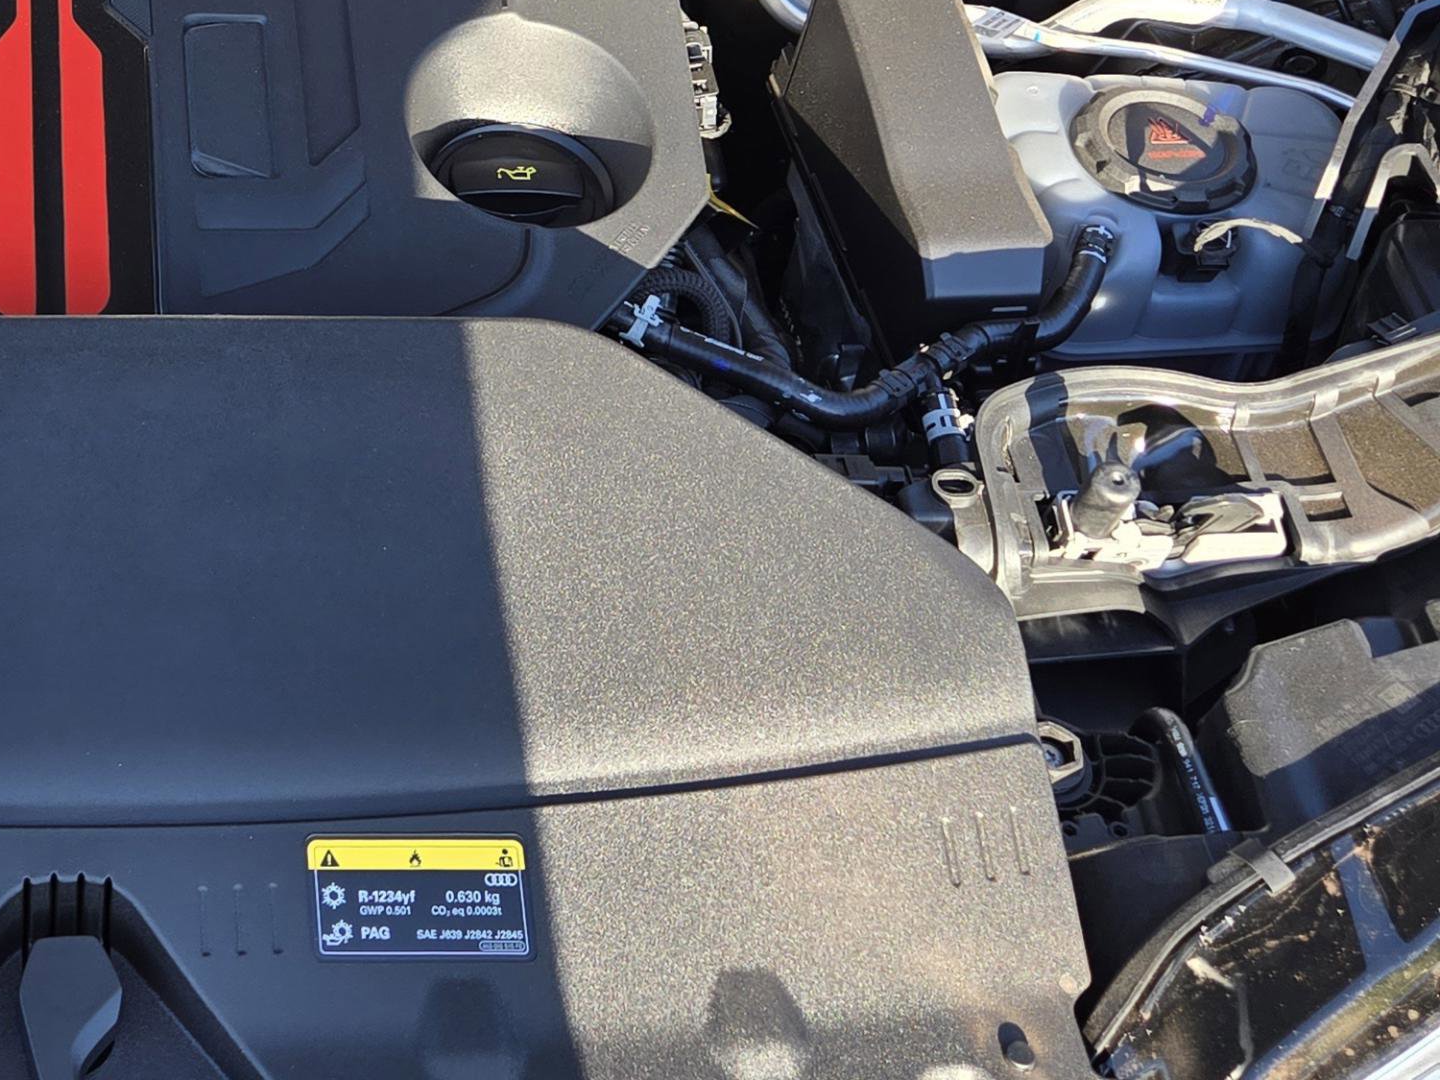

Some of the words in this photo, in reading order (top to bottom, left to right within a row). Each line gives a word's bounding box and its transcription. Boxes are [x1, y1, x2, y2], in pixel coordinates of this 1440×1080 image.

[358, 890, 416, 904] R-1234yf
[445, 890, 482, 904] 0.630
[483, 890, 501, 906] kg
[359, 905, 384, 916] GWP
[386, 905, 412, 915] 0.501
[452, 905, 465, 917] eq
[360, 926, 391, 940] PAG
[416, 929, 438, 940] SAE
[464, 929, 493, 940] J2842
[494, 929, 524, 940] J2845
